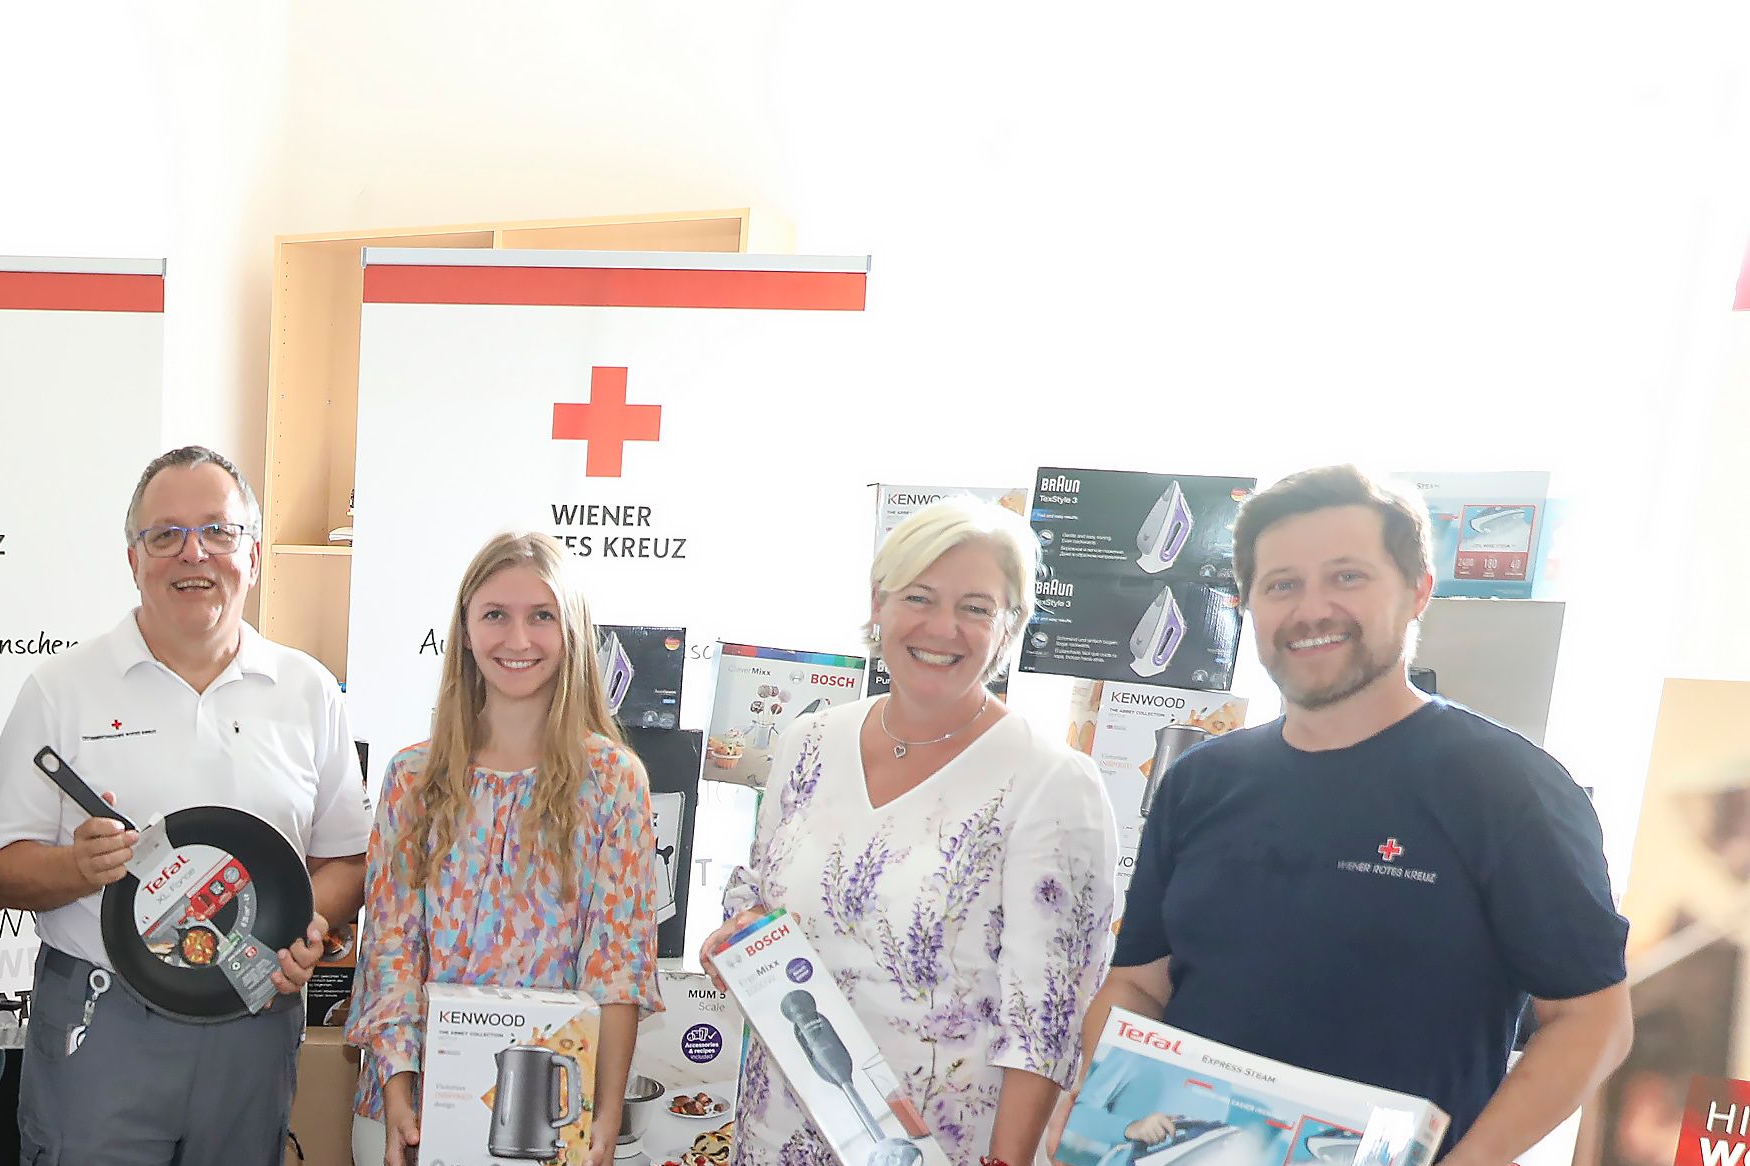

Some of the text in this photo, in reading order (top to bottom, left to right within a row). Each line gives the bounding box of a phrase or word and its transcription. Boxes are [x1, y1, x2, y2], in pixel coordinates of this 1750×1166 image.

[1040, 476, 1081, 493] BRAUN
[1039, 495, 1070, 505] TexStyle
[551, 504, 652, 527] WIENER
[603, 537, 687, 559] KREUZ
[1035, 579, 1073, 597] BRAUN
[810, 673, 855, 689] BOSCH
[1111, 692, 1186, 709] KENWOOD
[143, 854, 191, 896] Tefal
[1372, 864, 1403, 878] ROTES
[1403, 869, 1437, 884] KREUZ
[745, 923, 790, 958] BOSCH
[688, 988, 716, 1000] MUM
[698, 1001, 726, 1012] Scale
[439, 1010, 526, 1027] KENWOOD
[1117, 1019, 1184, 1056] Tefal
[1202, 1055, 1277, 1085] EXPRESS STEAM
